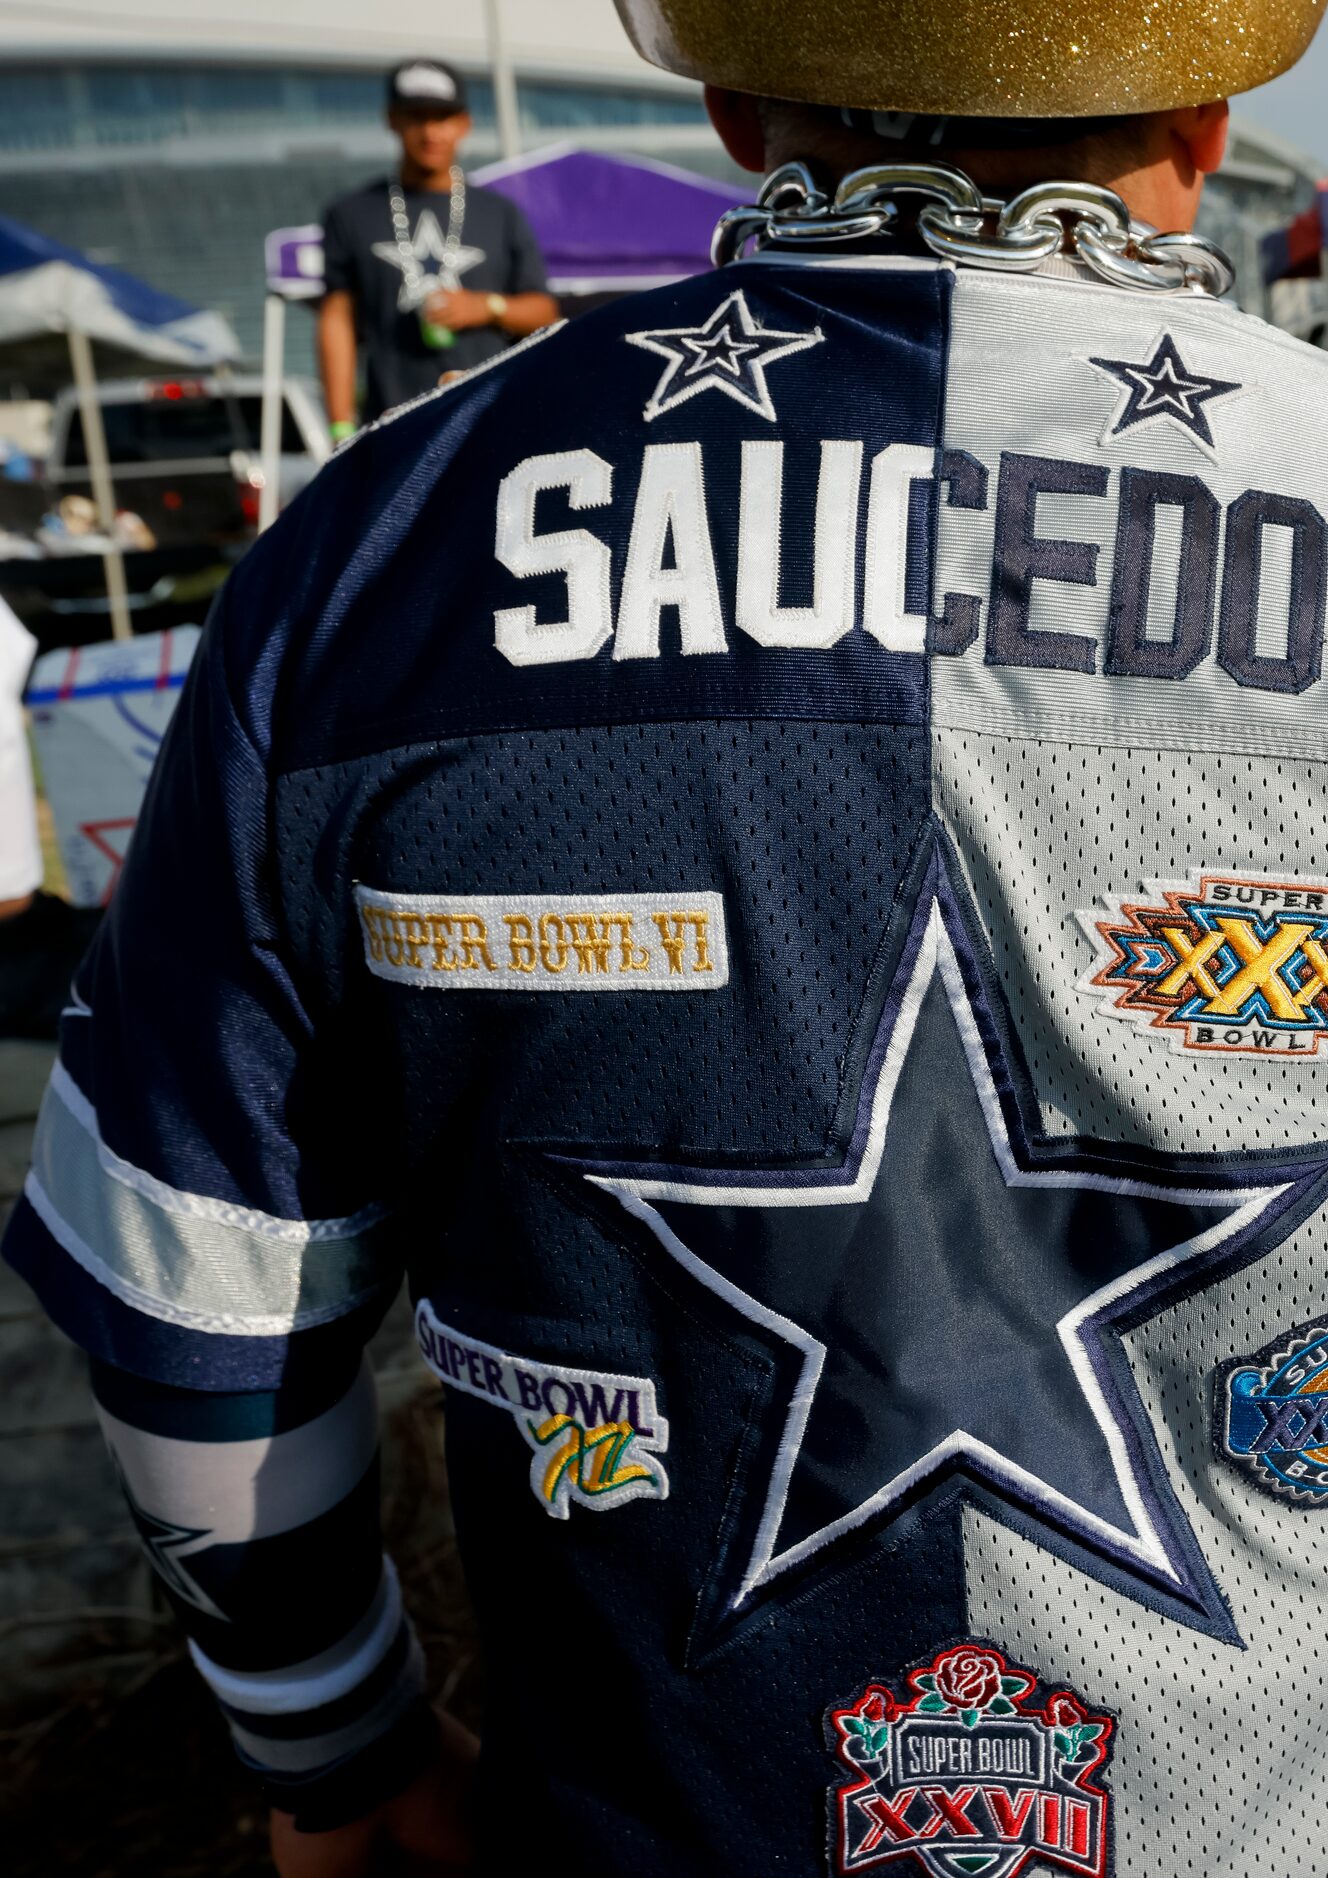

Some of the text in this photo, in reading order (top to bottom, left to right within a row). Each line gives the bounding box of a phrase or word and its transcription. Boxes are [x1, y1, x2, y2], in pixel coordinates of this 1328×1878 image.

[493, 439, 1328, 696] SAUCEDO
[1211, 885, 1324, 911] SUPER
[362, 905, 713, 975] SUPER BOWL VI
[1196, 1027, 1305, 1050] BOWL
[418, 1311, 654, 1438] SUPER BOWL
[907, 1735, 1035, 1776] SUPER BOWL
[851, 1783, 1091, 1858] XXVII
